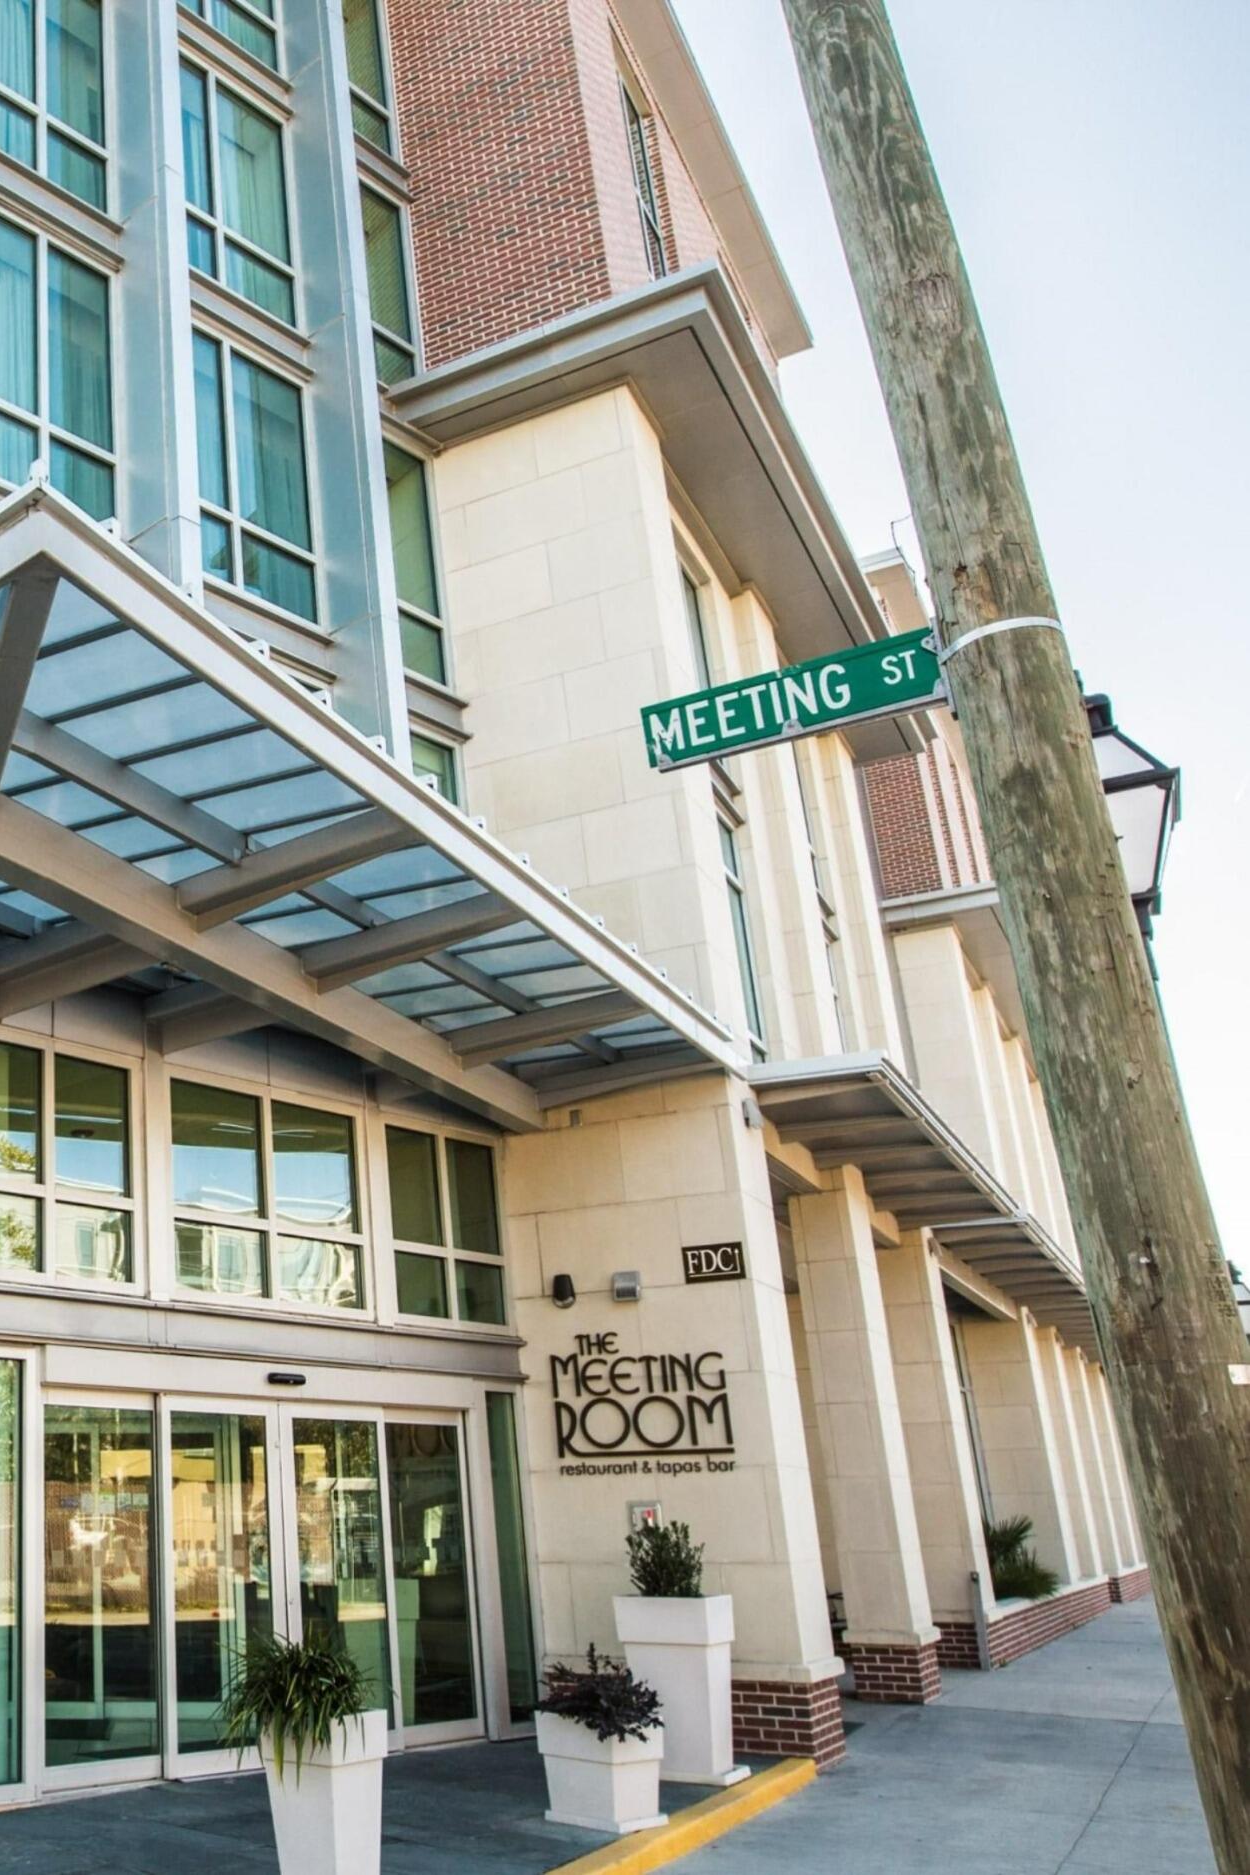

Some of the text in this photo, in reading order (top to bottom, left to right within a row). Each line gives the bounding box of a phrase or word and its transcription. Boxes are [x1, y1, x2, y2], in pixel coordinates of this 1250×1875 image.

[649, 650, 917, 751] MEETING ST
[685, 1247, 734, 1276] FDC
[574, 1332, 619, 1356] THE
[550, 1351, 727, 1398] MEETING
[554, 1393, 735, 1458] ROOM
[560, 1455, 736, 1477] restaurant & tapas bar
